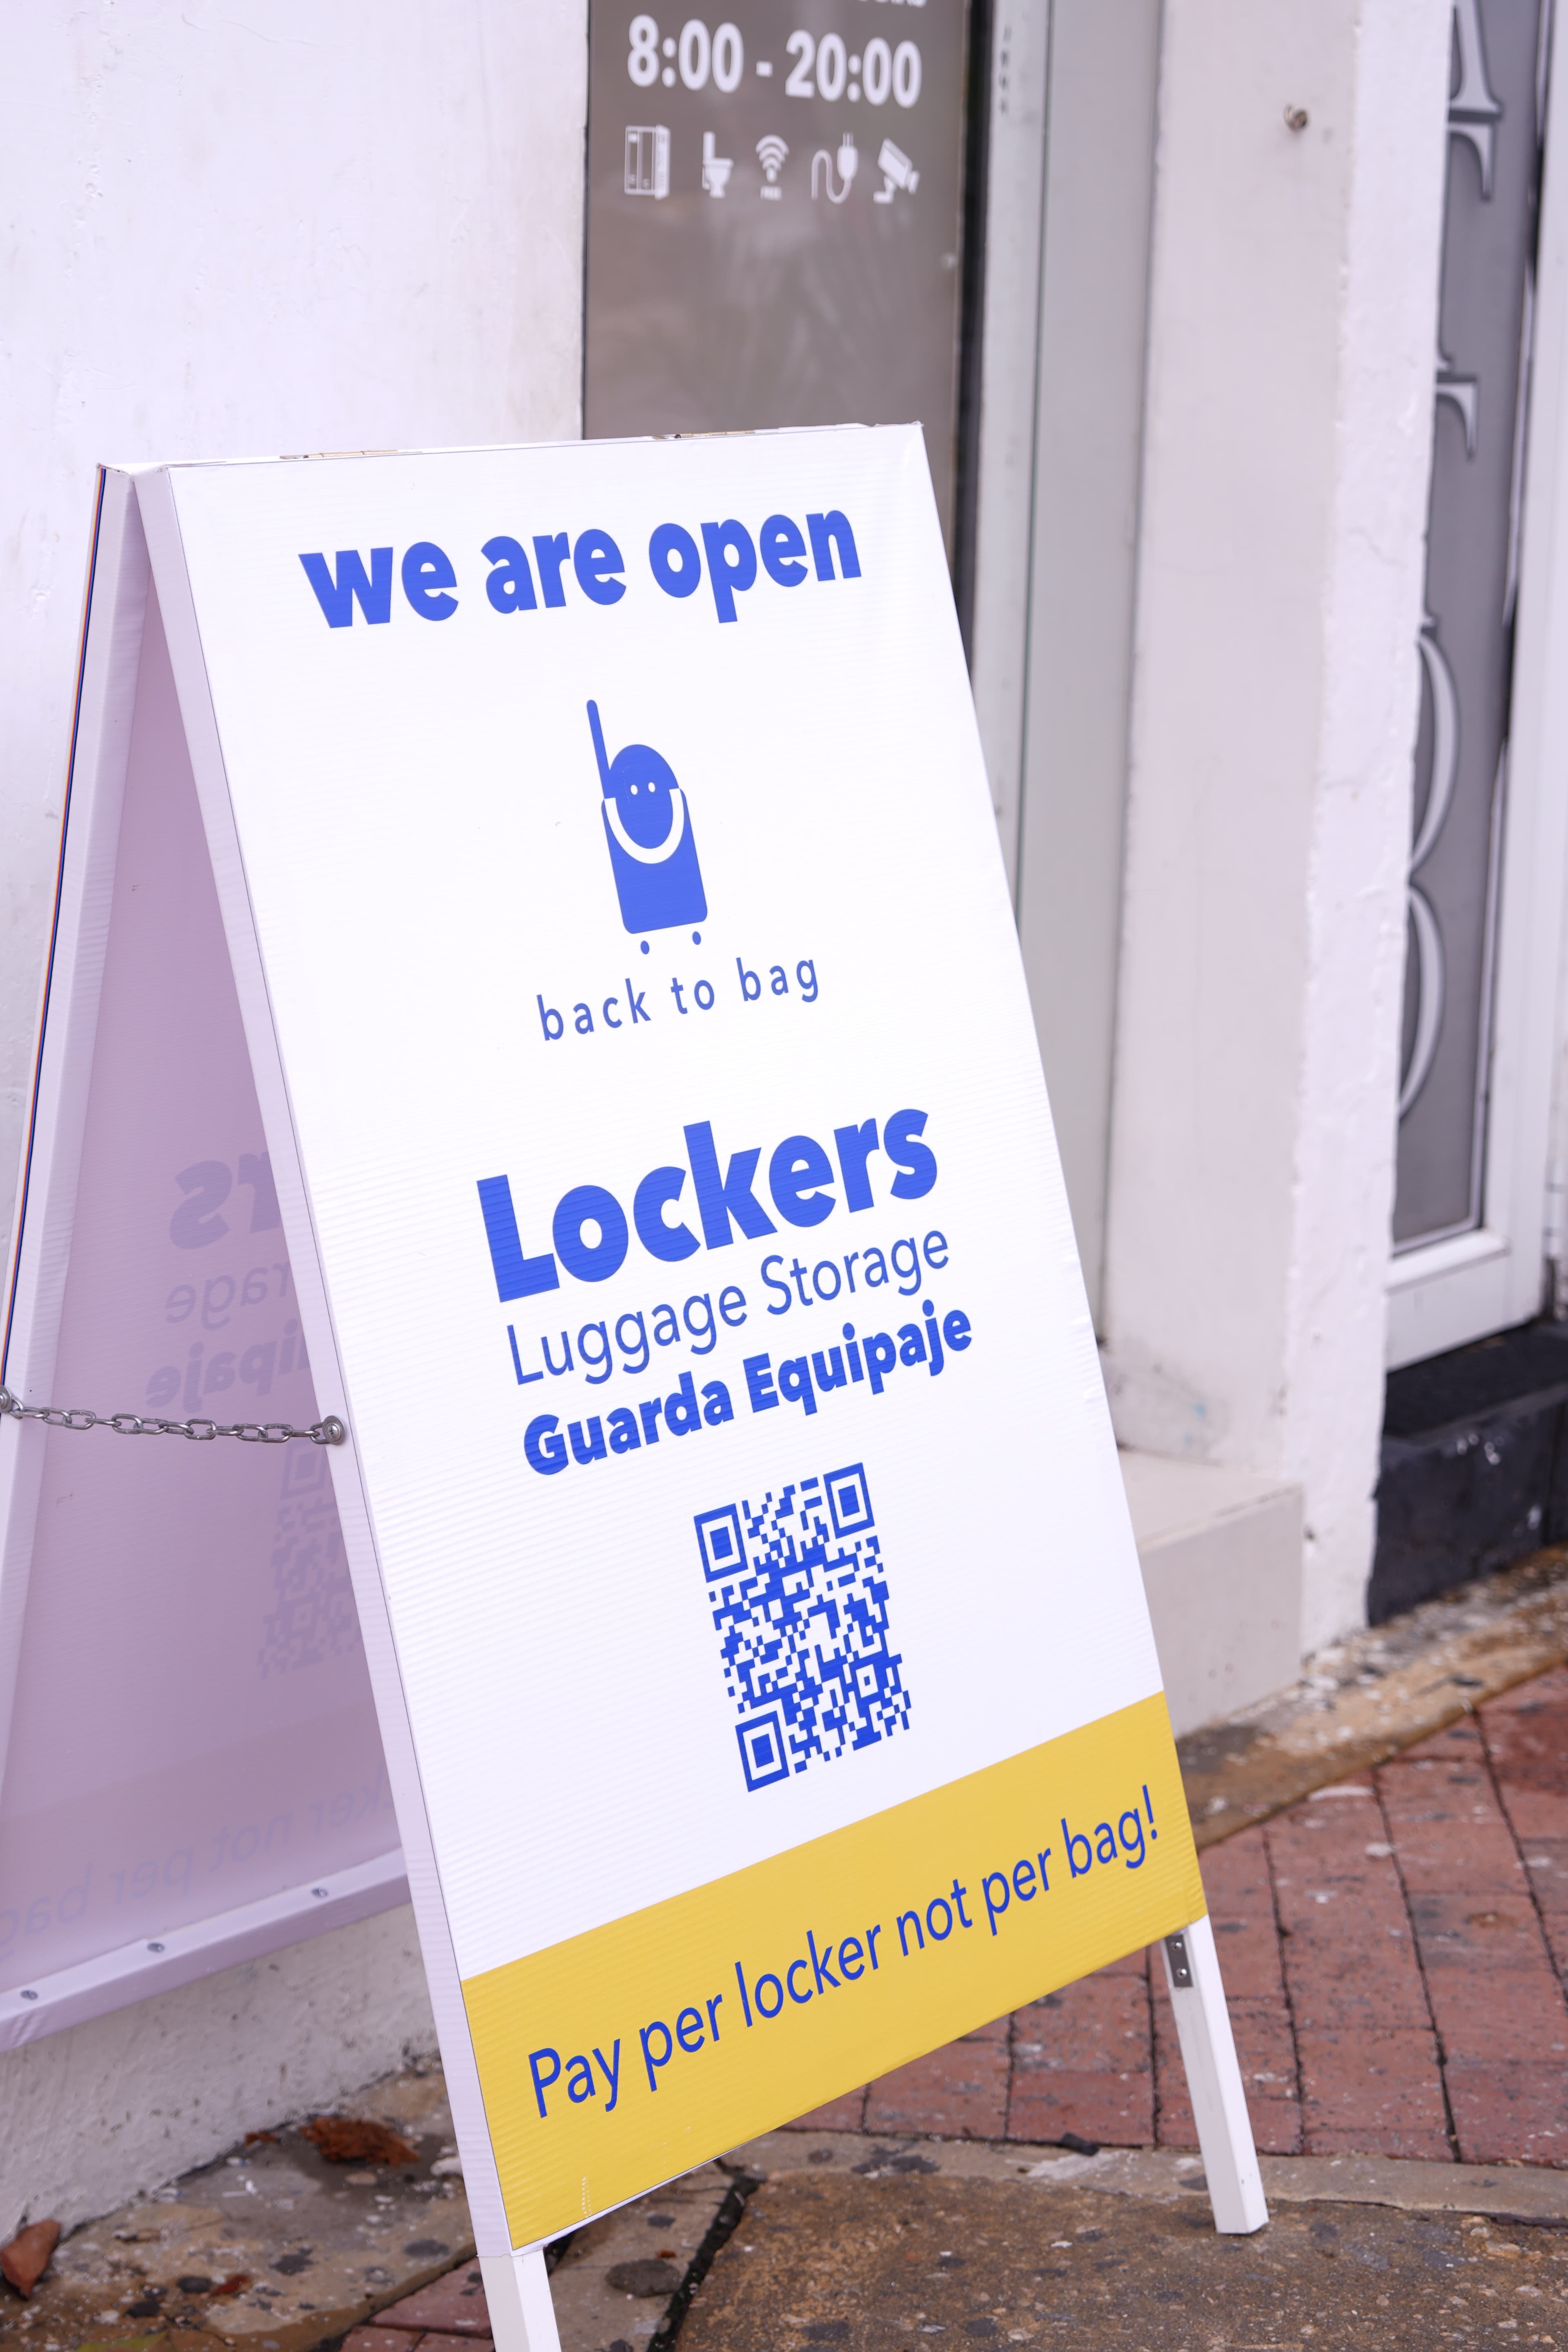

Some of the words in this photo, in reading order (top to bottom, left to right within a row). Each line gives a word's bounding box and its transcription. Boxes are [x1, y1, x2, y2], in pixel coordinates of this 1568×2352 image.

[627, 15, 744, 93] 8:00
[756, 61, 773, 76] -
[786, 30, 922, 108] 20:00
[299, 542, 458, 628] we
[481, 529, 626, 614] are
[649, 510, 861, 623] open
[537, 978, 650, 1040] back
[671, 978, 714, 1014] to
[737, 958, 818, 1002] bag
[477, 1109, 937, 1302] Lockers
[507, 1286, 747, 1385] Luggage
[761, 1231, 948, 1314] Storage
[524, 1371, 734, 1475] Guarda
[743, 1300, 971, 1415] Equipaje
[529, 2038, 620, 2118] Pay
[639, 1994, 722, 2091] per
[735, 1925, 880, 2027] locker
[897, 1879, 972, 1956] not
[982, 1848, 1051, 1936] per
[1061, 1785, 1157, 1878] bag!
